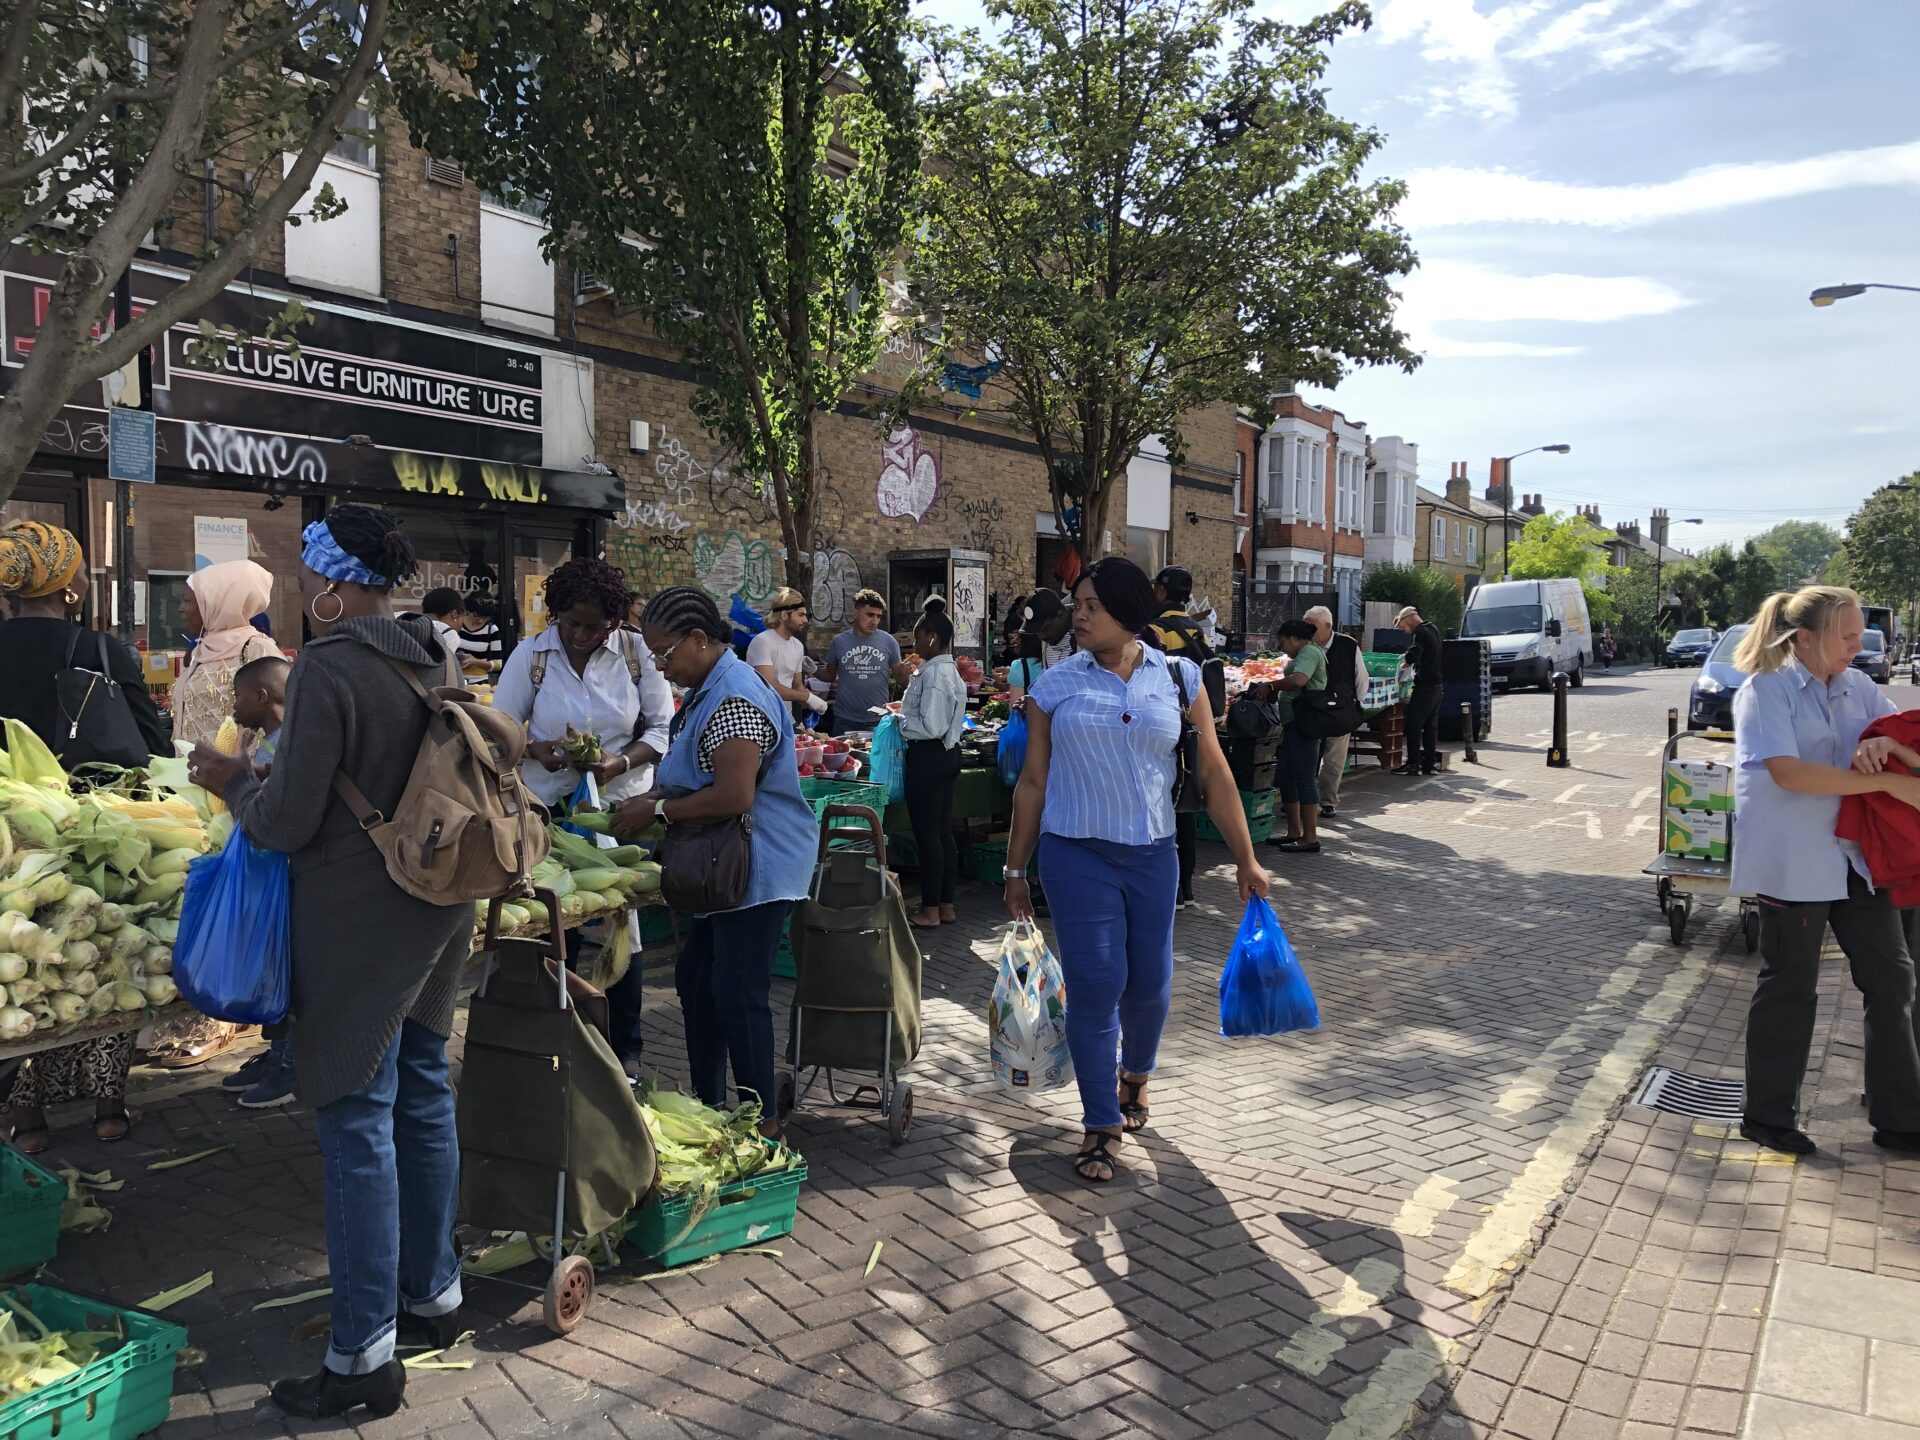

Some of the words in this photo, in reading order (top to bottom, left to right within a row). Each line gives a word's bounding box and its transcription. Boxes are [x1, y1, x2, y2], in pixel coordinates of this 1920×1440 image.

[507, 358, 517, 368] 38
[524, 362, 534, 372] 40
[182, 337, 335, 388] CLUSIVE
[340, 366, 470, 410] FURNITURE
[478, 388, 535, 420] URE
[197, 522, 245, 534] FINANCE
[841, 645, 885, 664] COMPTON
